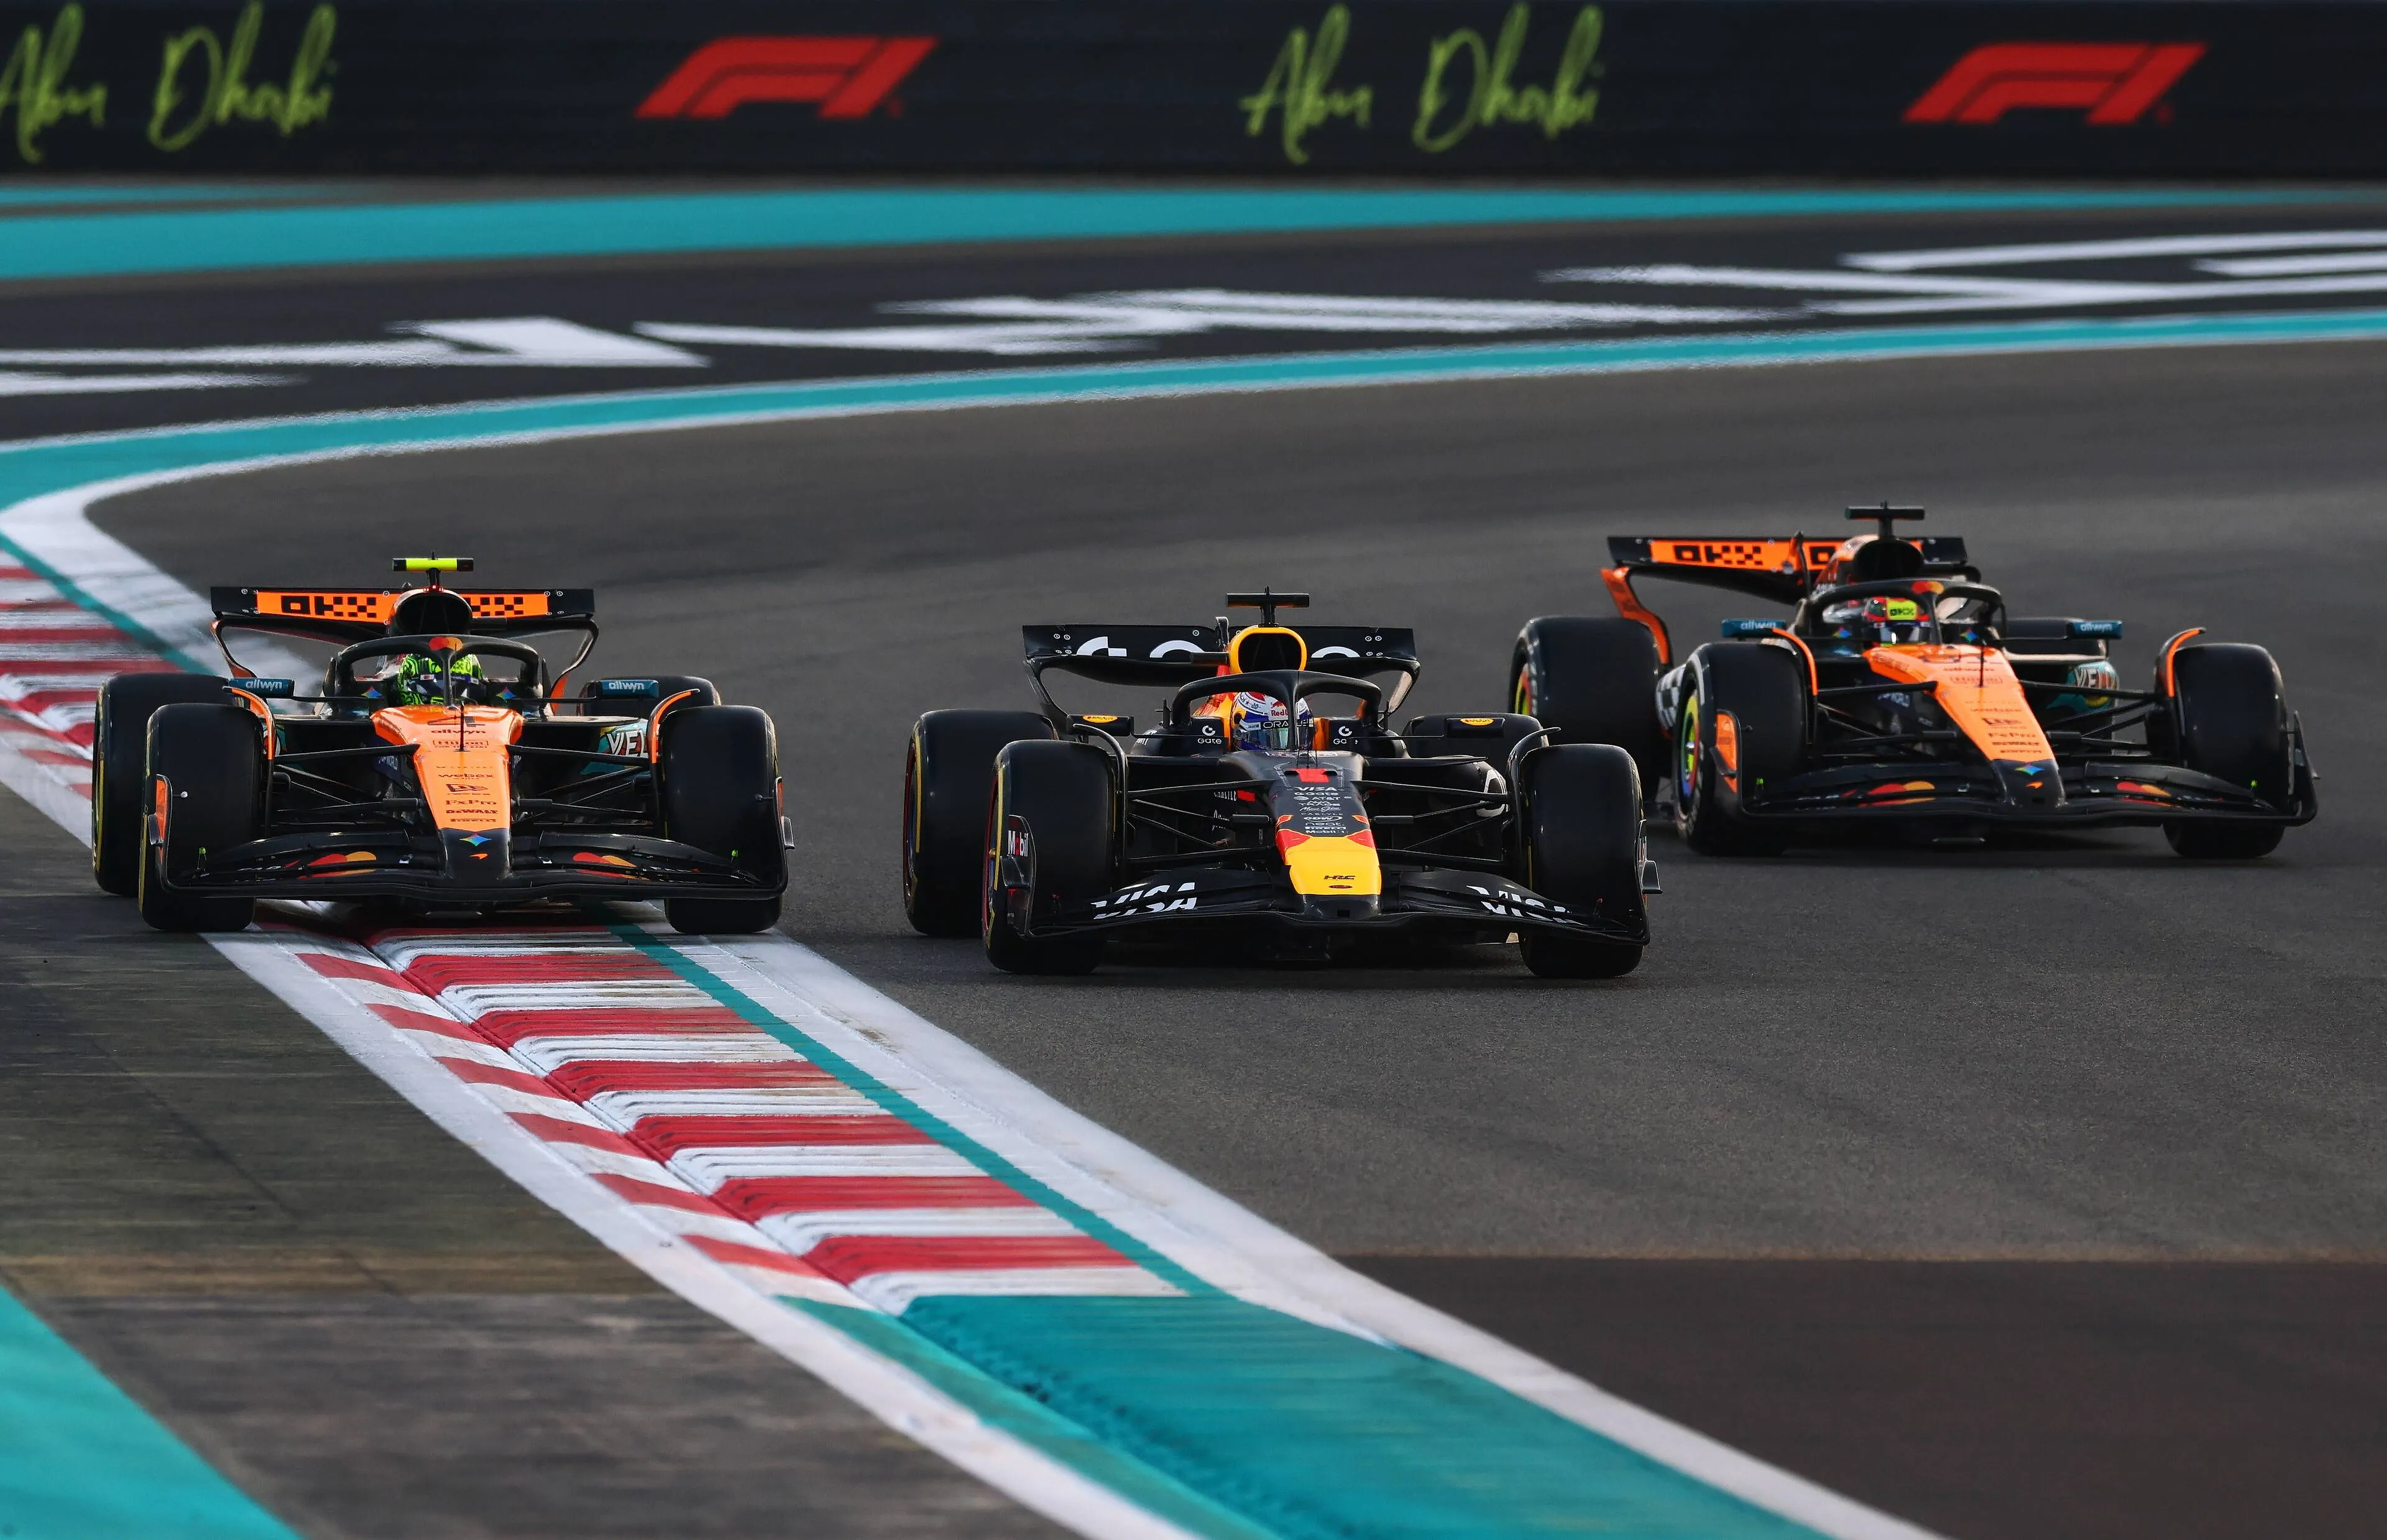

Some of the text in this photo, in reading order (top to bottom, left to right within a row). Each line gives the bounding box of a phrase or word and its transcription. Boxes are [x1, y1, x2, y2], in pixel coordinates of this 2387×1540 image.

[0, 1, 339, 164] Abu Dhabi
[1239, 1, 1606, 164] Abu Dhabi
[281, 595, 377, 619] OKX
[1741, 620, 1776, 630] allwyn
[2079, 622, 2113, 633] allwyn
[245, 679, 283, 692] allwyn
[609, 681, 645, 693] allwyn
[1008, 830, 1029, 857] Mobil
[1090, 882, 1197, 920] VISA
